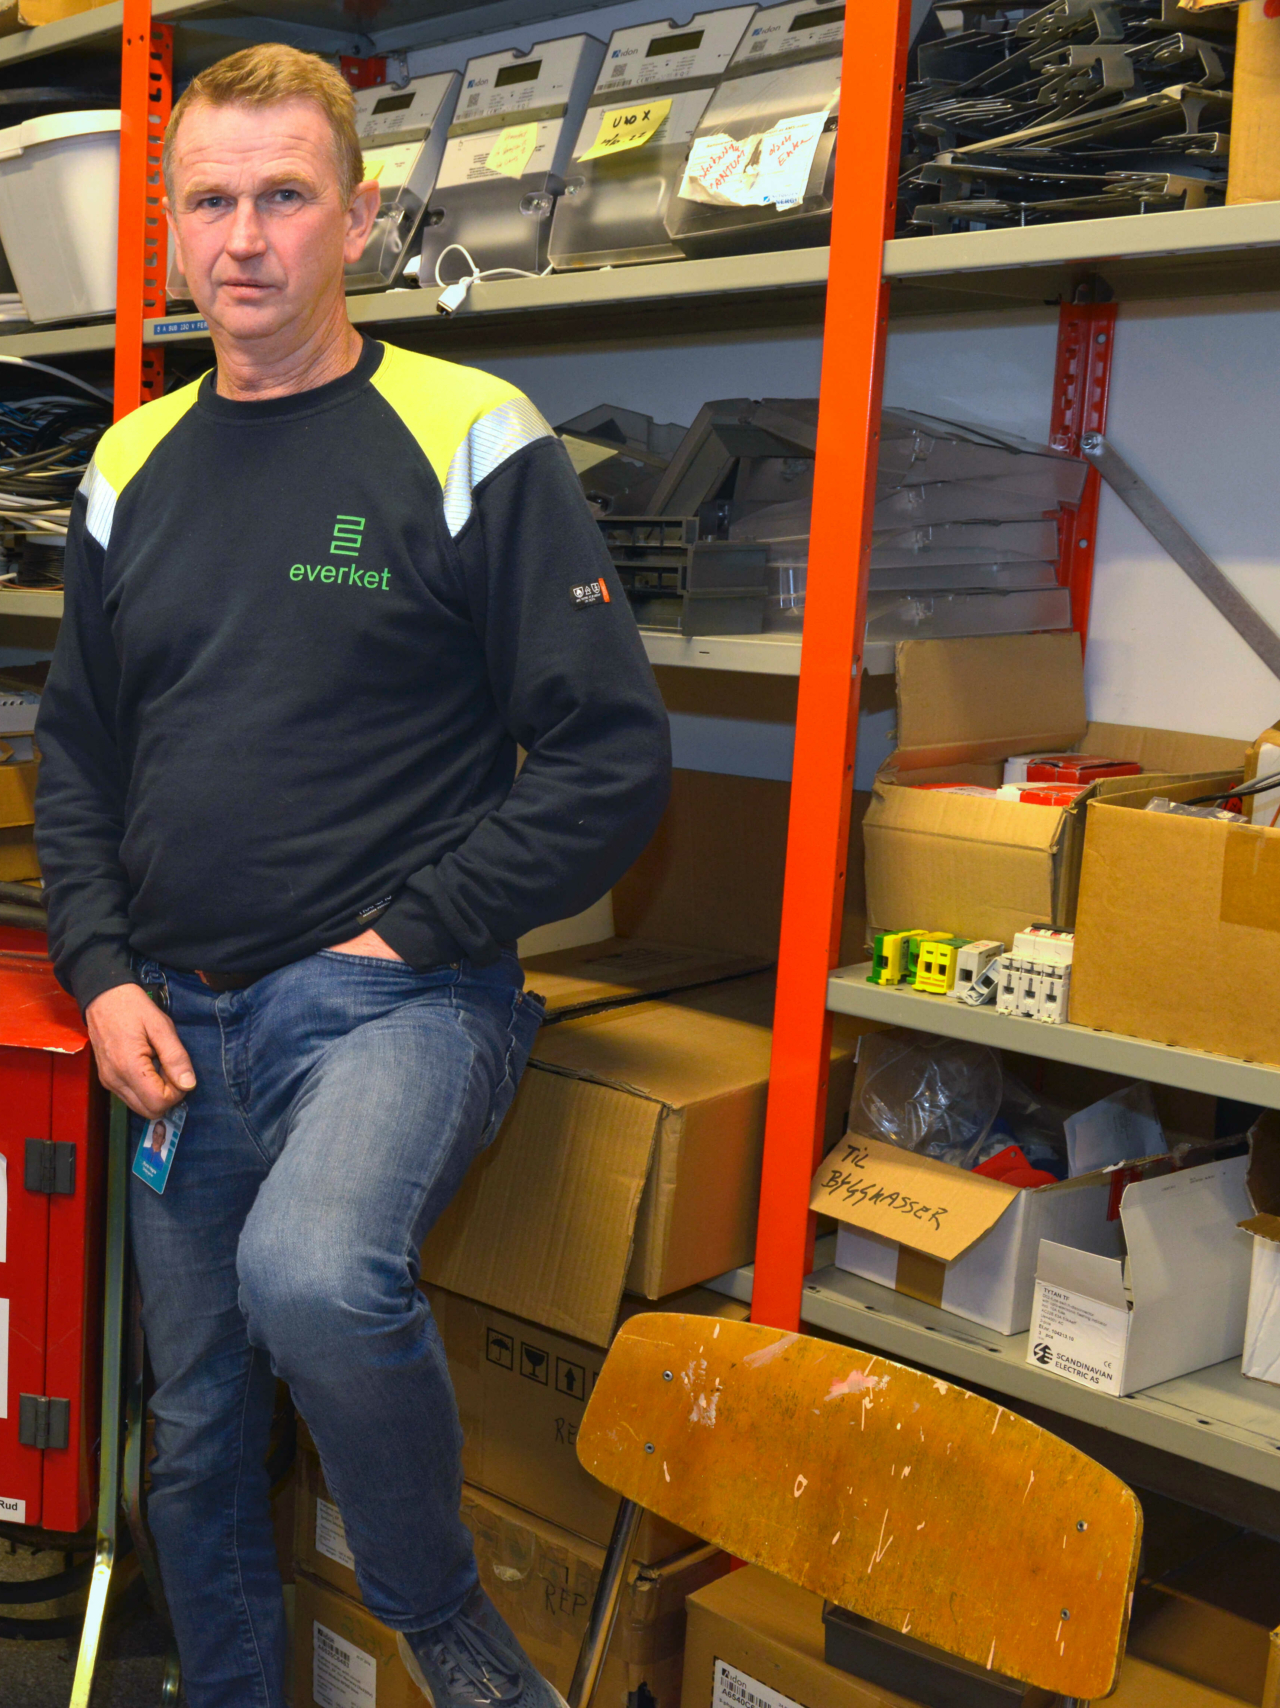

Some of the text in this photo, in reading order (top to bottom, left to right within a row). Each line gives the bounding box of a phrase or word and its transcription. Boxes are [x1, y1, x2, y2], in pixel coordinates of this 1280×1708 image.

[288, 563, 392, 591] everket
[1044, 1288, 1062, 1299] TYTAN
[1055, 1360, 1088, 1380] ELECTRIC
[1056, 1352, 1113, 1380] SCANDINAVIAN
